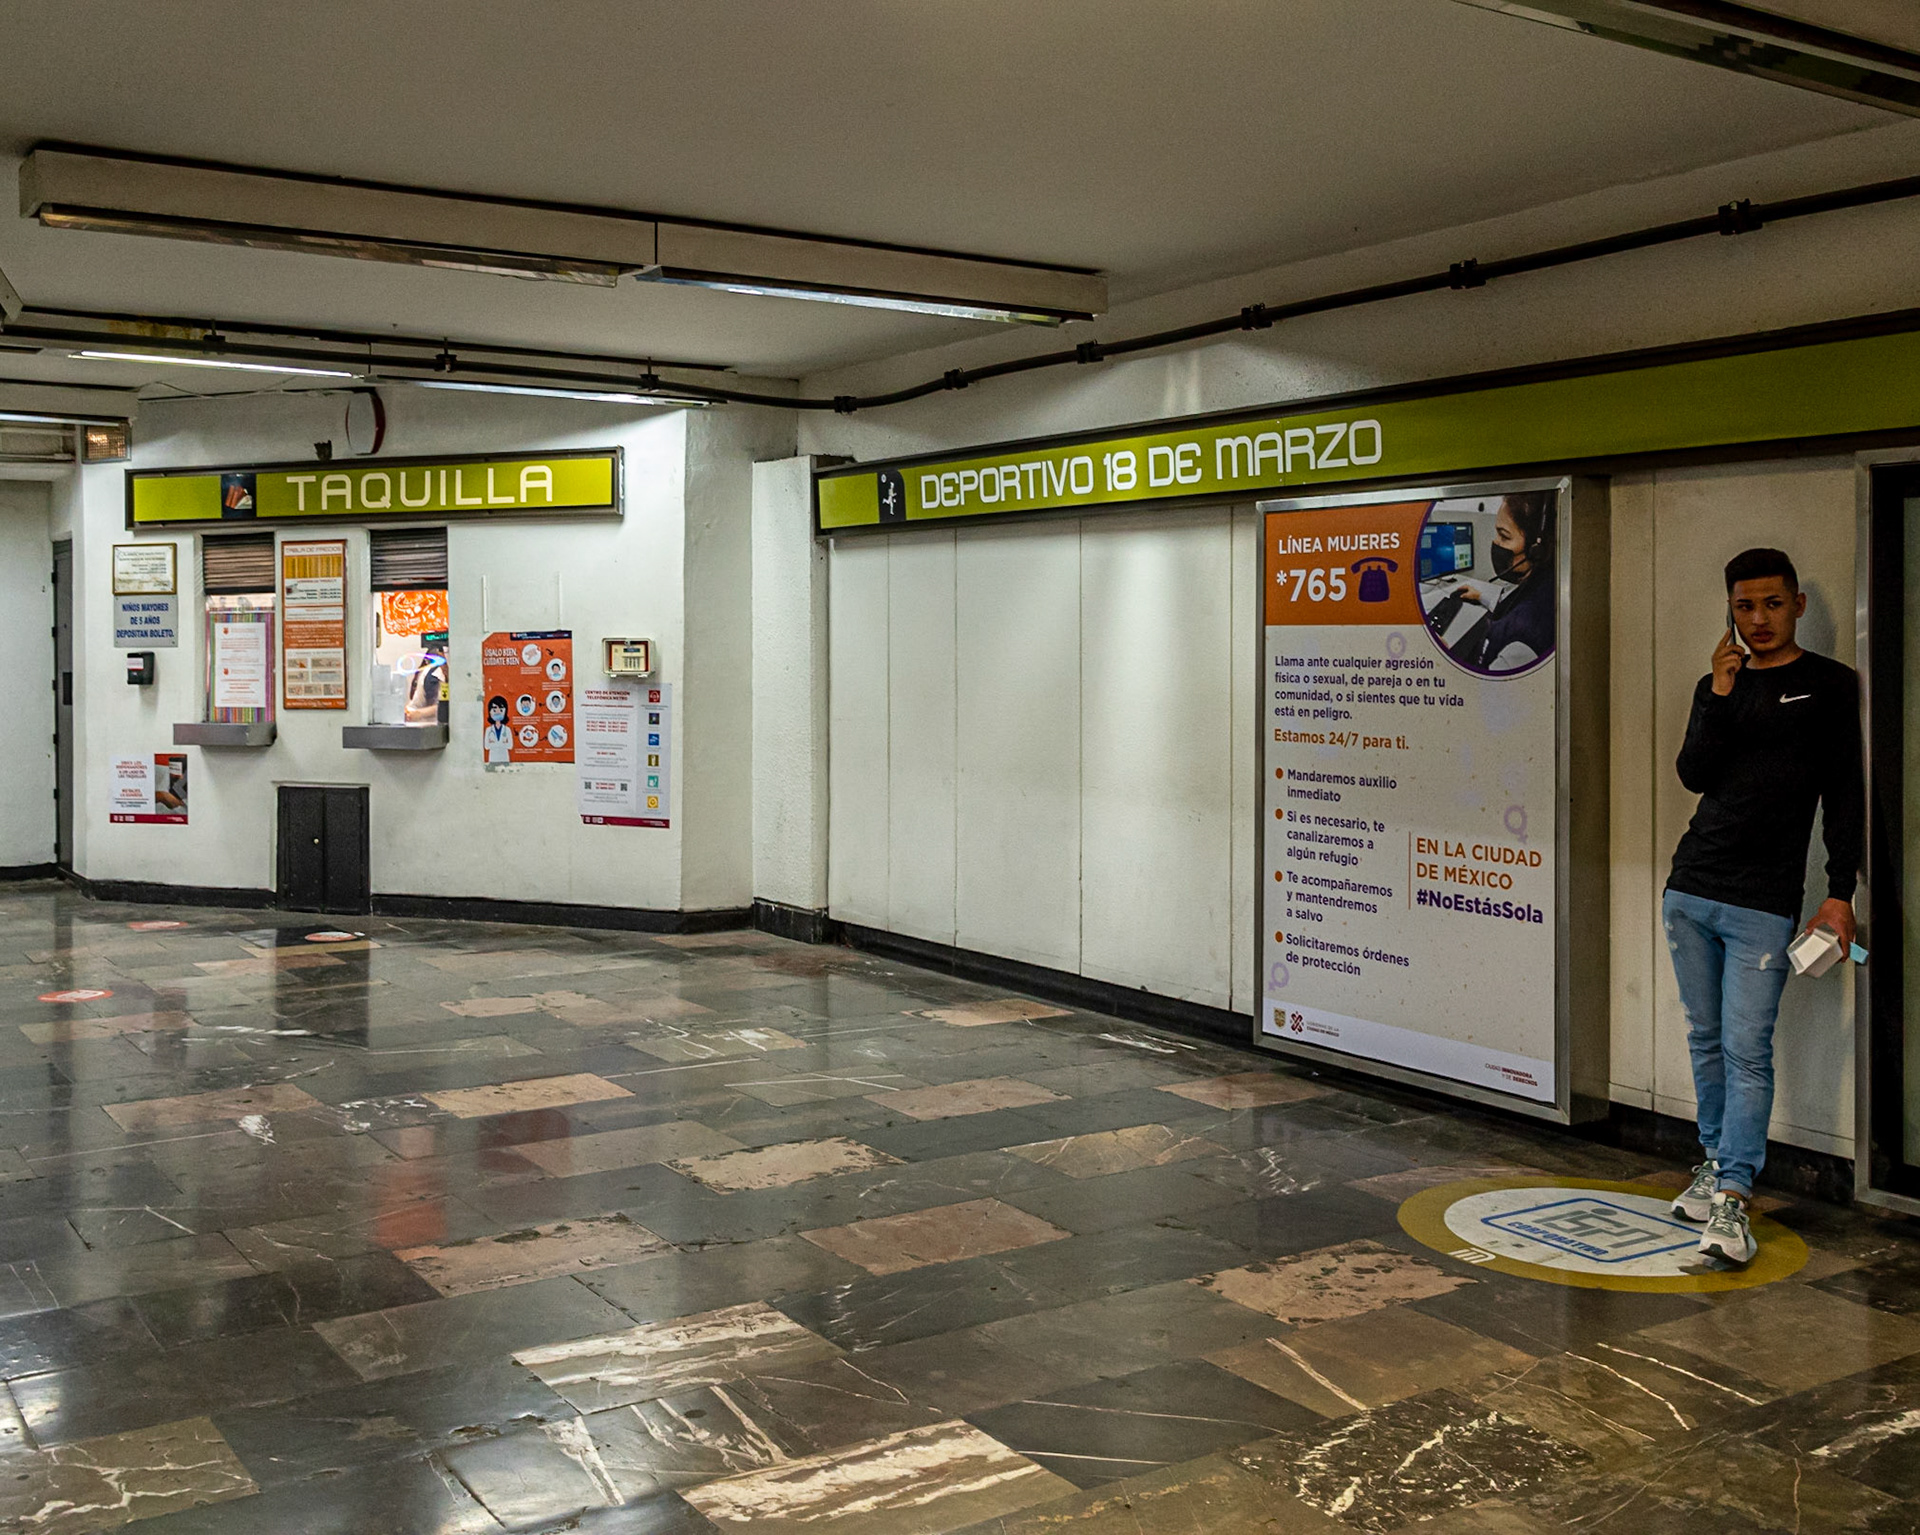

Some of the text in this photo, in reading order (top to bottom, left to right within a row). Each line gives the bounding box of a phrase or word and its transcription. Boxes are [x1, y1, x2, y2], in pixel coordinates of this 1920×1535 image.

[921, 419, 1382, 510] DEPORTIVO 18 DE MARZO
[286, 465, 552, 511] TAQUILLA
[1278, 532, 1400, 554] LÍNEA MUJERES
[122, 602, 169, 612] NIÑOS MAYORES
[131, 614, 160, 625] DE 5 AÑOS
[116, 629, 174, 638] DEPOSITAN BOLETO.
[1275, 656, 1434, 670] Llama ante cualquier agresión
[1275, 672, 1300, 683] física
[1313, 674, 1348, 686] sexual,
[1351, 674, 1364, 685] de
[1367, 676, 1402, 688] pareja
[1405, 678, 1413, 687] o
[1416, 678, 1430, 687] en
[1434, 677, 1446, 687] tu
[1275, 690, 1333, 703] comunidad,
[1346, 692, 1354, 702] si
[1357, 692, 1396, 704] sientes
[1399, 695, 1420, 707] que
[1423, 694, 1435, 705] tu
[1439, 695, 1464, 707] vida
[1275, 705, 1352, 721] está en peligro.
[1274, 729, 1409, 750] Estamos 24/7 para ti.
[1287, 769, 1397, 789] Mandaremos auxilio
[1287, 786, 1341, 802] inmediato
[1287, 811, 1385, 833] Si es necesario, te
[1287, 830, 1374, 849] canalizaremos a
[1287, 846, 1358, 867] algún refugio
[1416, 837, 1542, 867] EN LA CIUDAD
[1287, 871, 1393, 897] Te acompañaremos
[1416, 862, 1514, 890] DE MÉXICO
[1286, 890, 1378, 914] y mantendremos
[1416, 888, 1543, 924] #NoEstásSola
[1286, 908, 1323, 922] a salvo
[1286, 933, 1410, 967] Solicitaremos órdenes
[1286, 951, 1361, 976] de protección
